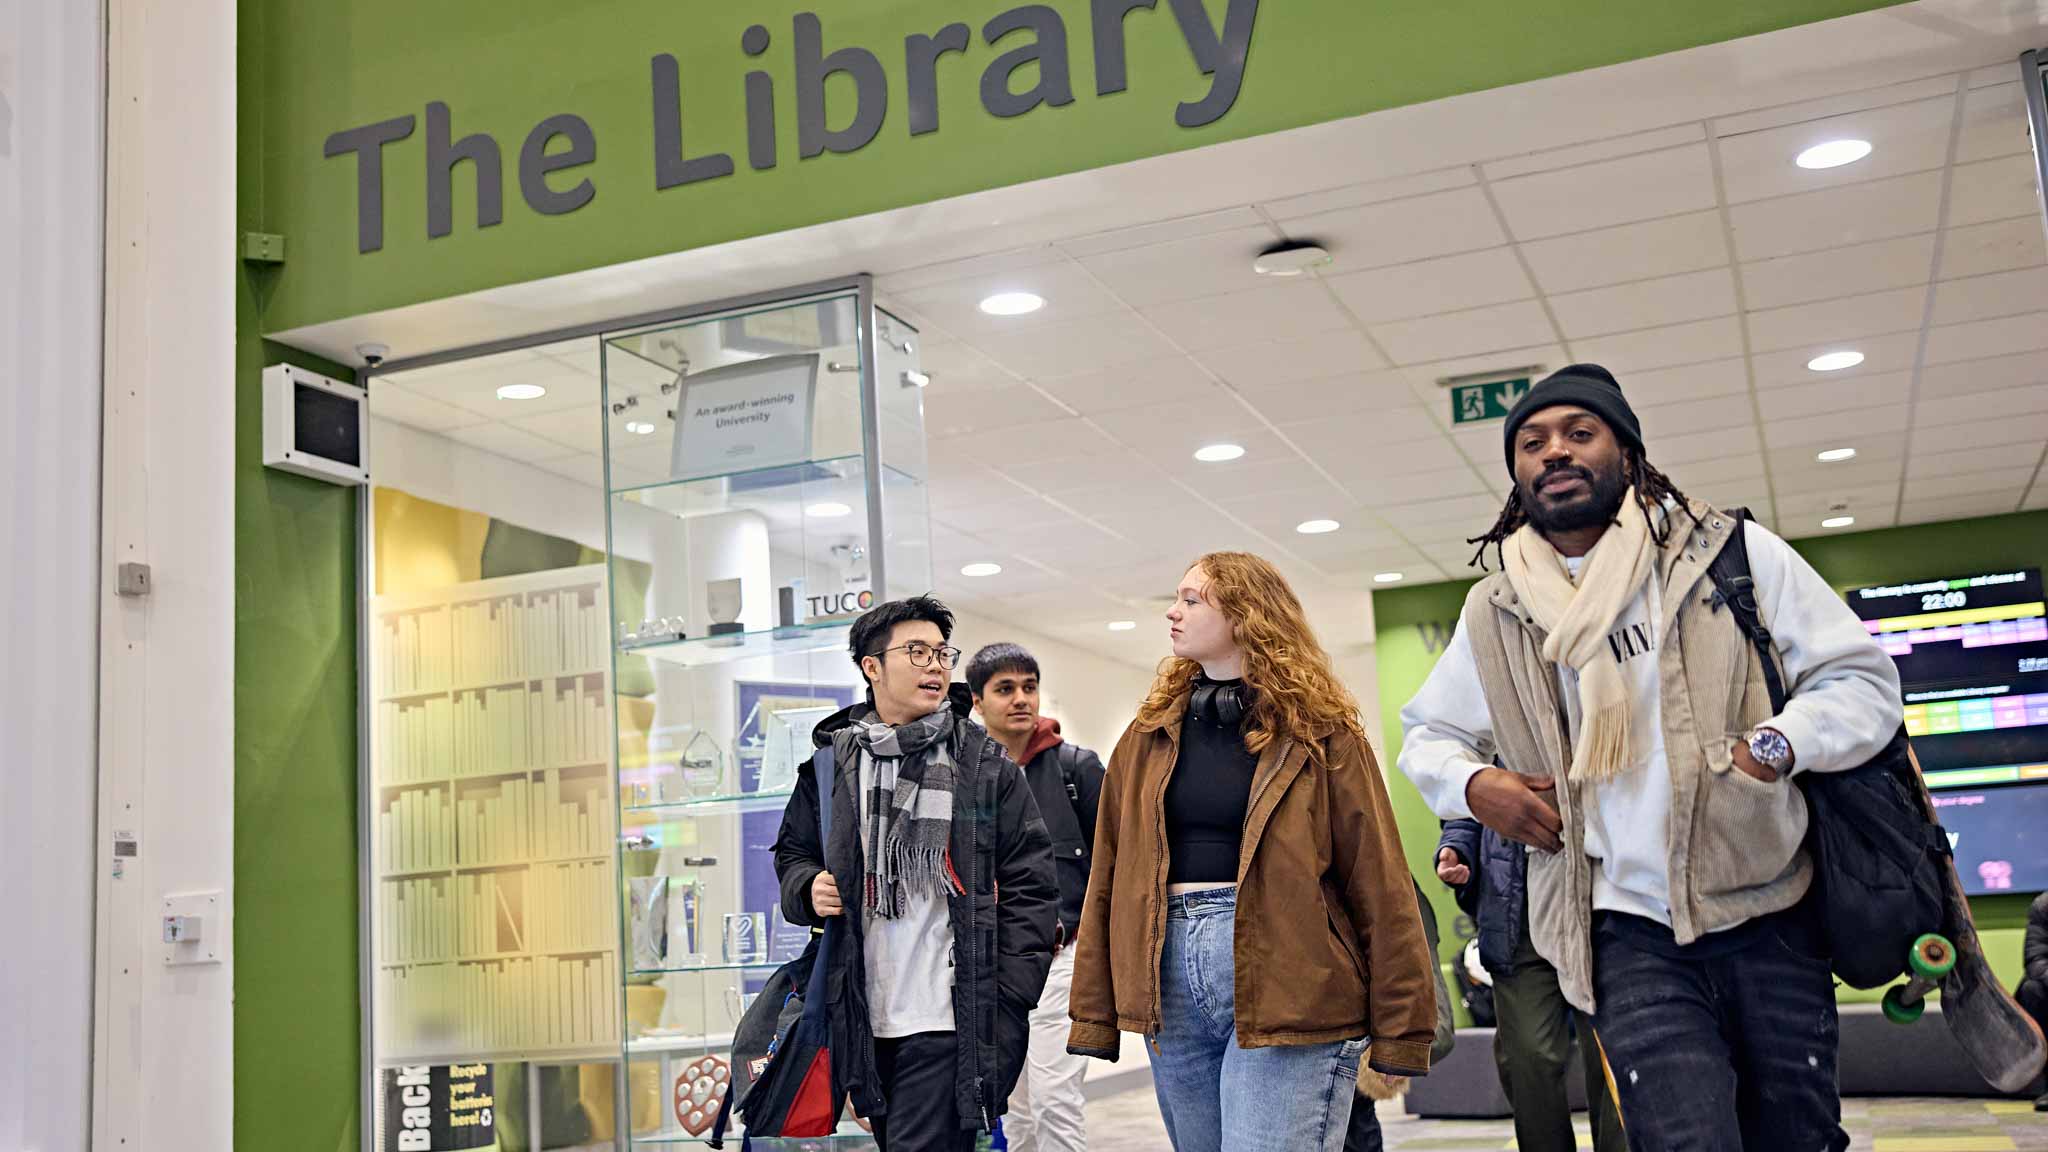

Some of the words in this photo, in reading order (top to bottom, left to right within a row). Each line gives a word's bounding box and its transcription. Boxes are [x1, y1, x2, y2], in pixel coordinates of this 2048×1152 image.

[323, 101, 597, 254] The
[649, 0, 1260, 190] Library
[695, 407, 711, 418] An
[715, 411, 771, 429] University
[807, 591, 873, 616] TUCO
[1921, 590, 1967, 611] 22:00
[449, 1063, 487, 1079] Recycle
[449, 1082, 476, 1097] your
[450, 1110, 480, 1127] here!
